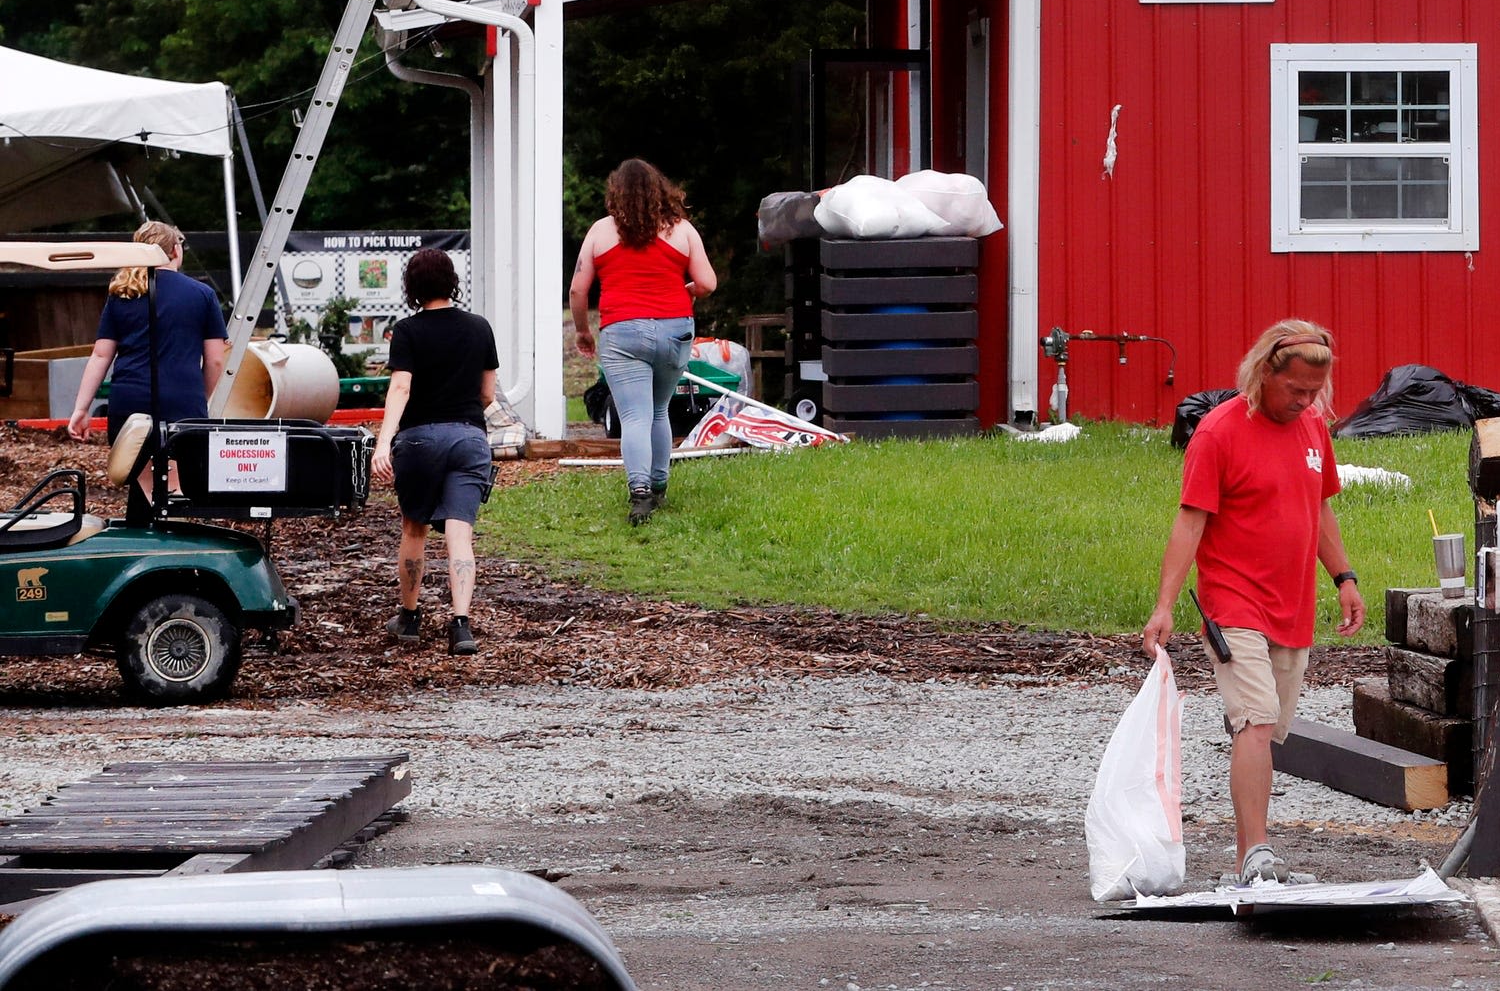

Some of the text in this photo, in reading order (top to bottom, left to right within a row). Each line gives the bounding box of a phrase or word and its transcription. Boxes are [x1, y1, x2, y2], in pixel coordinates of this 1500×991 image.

[324, 235, 422, 248] HOW TO PICK TULIPS
[225, 438, 270, 446] Reserved for
[220, 449, 276, 459] CONCESSIONS
[237, 463, 258, 472] ONLY
[19, 588, 43, 600] 249
